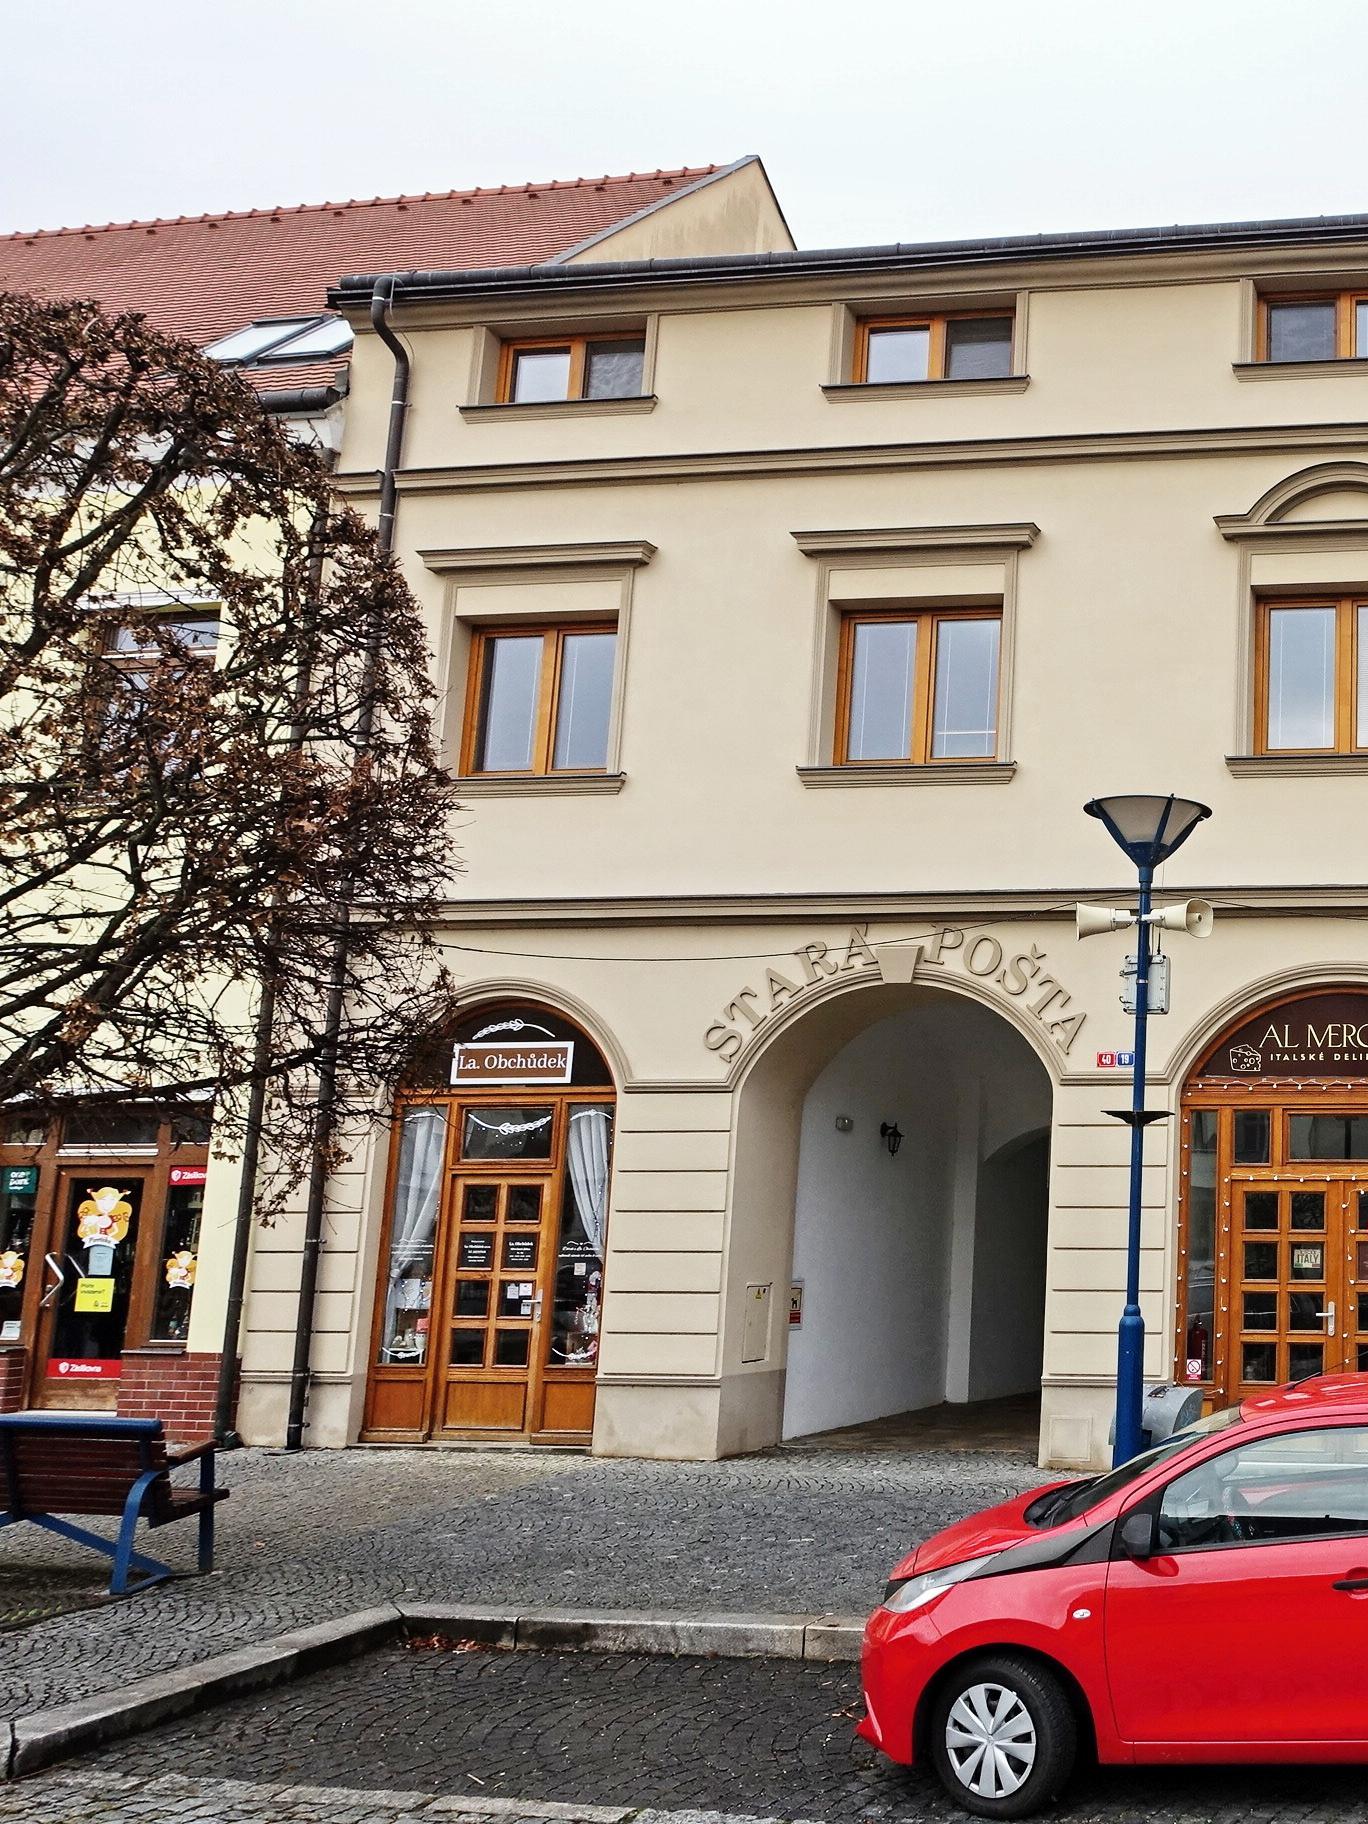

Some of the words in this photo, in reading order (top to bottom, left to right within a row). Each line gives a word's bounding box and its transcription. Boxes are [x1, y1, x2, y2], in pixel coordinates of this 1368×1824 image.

[703, 923, 879, 1063] STARÁ
[923, 923, 1086, 1055] POŠTA
[1259, 1024, 1299, 1048] AL
[458, 1055, 481, 1070] La.
[484, 1053, 568, 1070] Obchůdek
[1101, 1054, 1112, 1065] 40
[1120, 1054, 1130, 1065] 19
[1270, 1051, 1325, 1061] ITALSKÉ
[1296, 1254, 1320, 1264] ITALY
